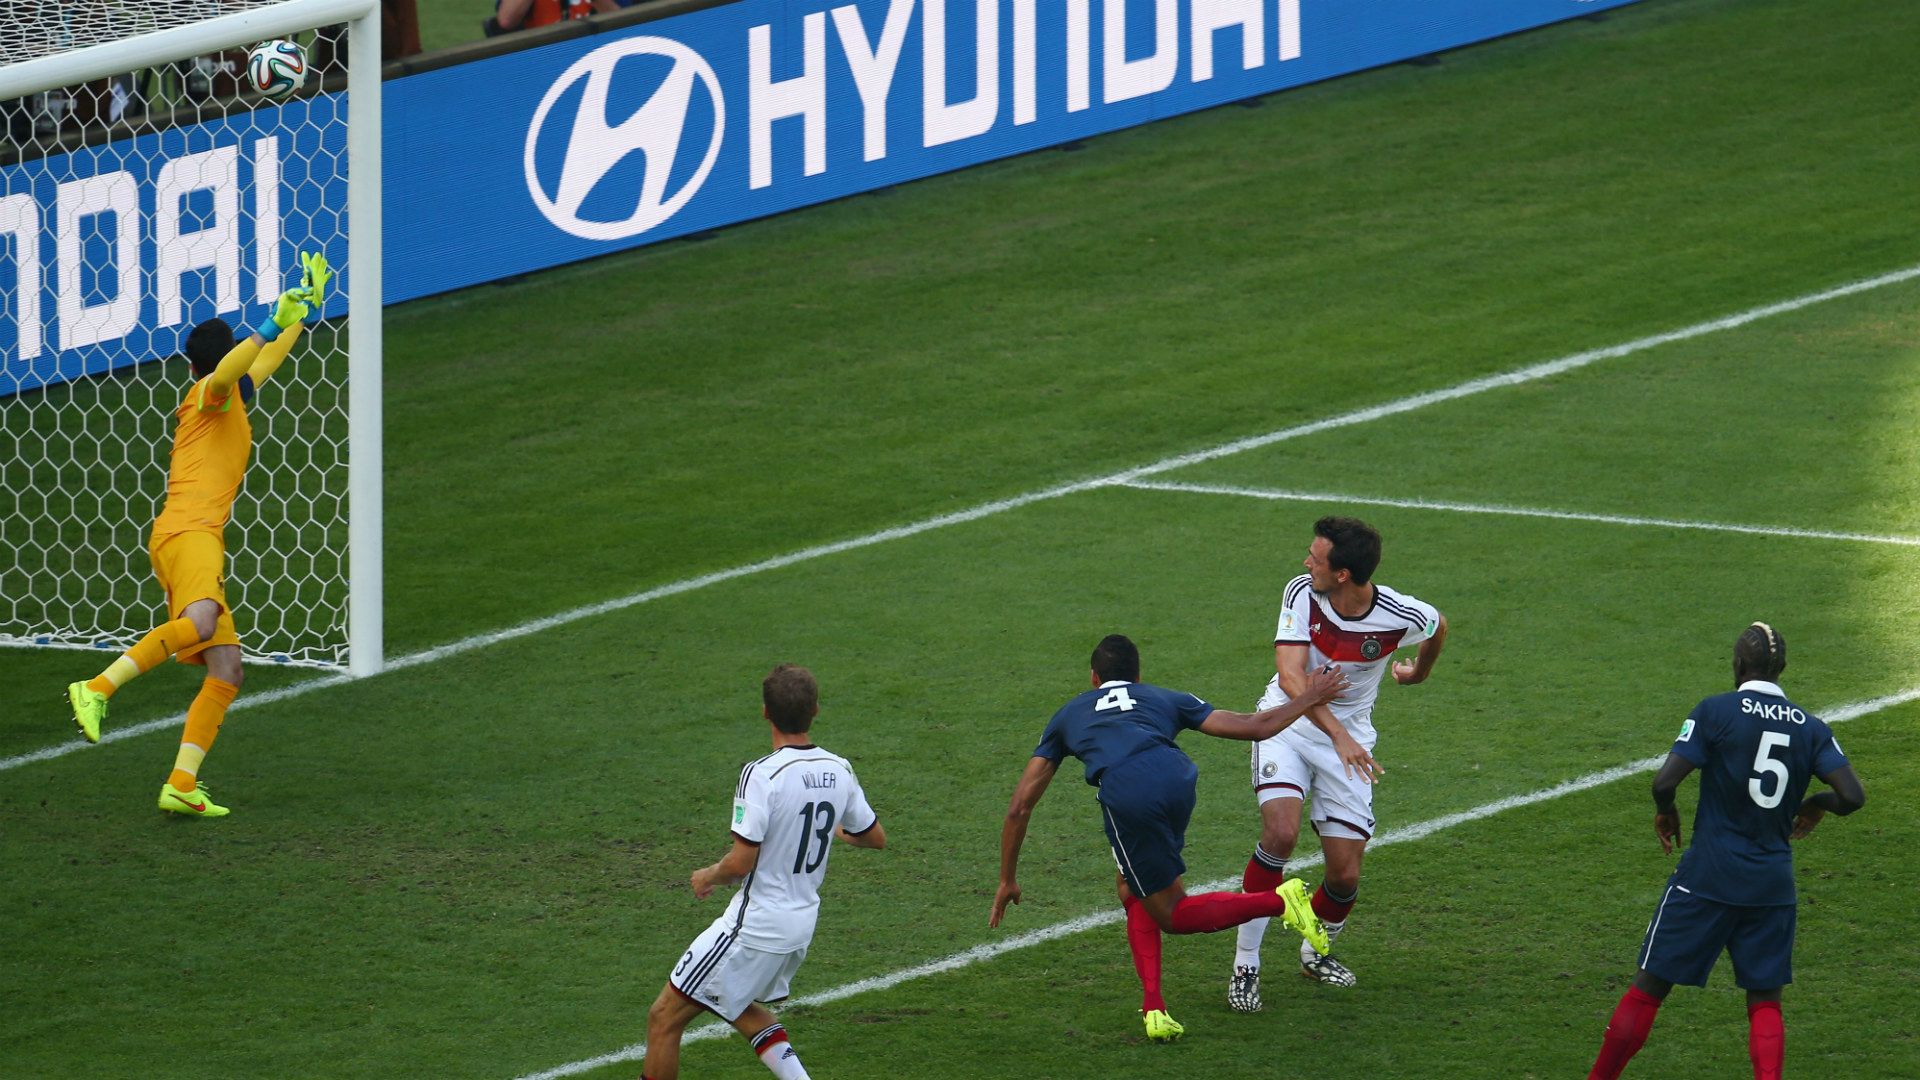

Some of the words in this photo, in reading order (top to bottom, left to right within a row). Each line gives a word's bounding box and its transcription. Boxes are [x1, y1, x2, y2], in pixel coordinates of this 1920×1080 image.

[1095, 687, 1137, 712] 4
[1741, 697, 1806, 725] SAKHO
[1748, 730, 1791, 809] 5
[793, 801, 836, 874] 13
